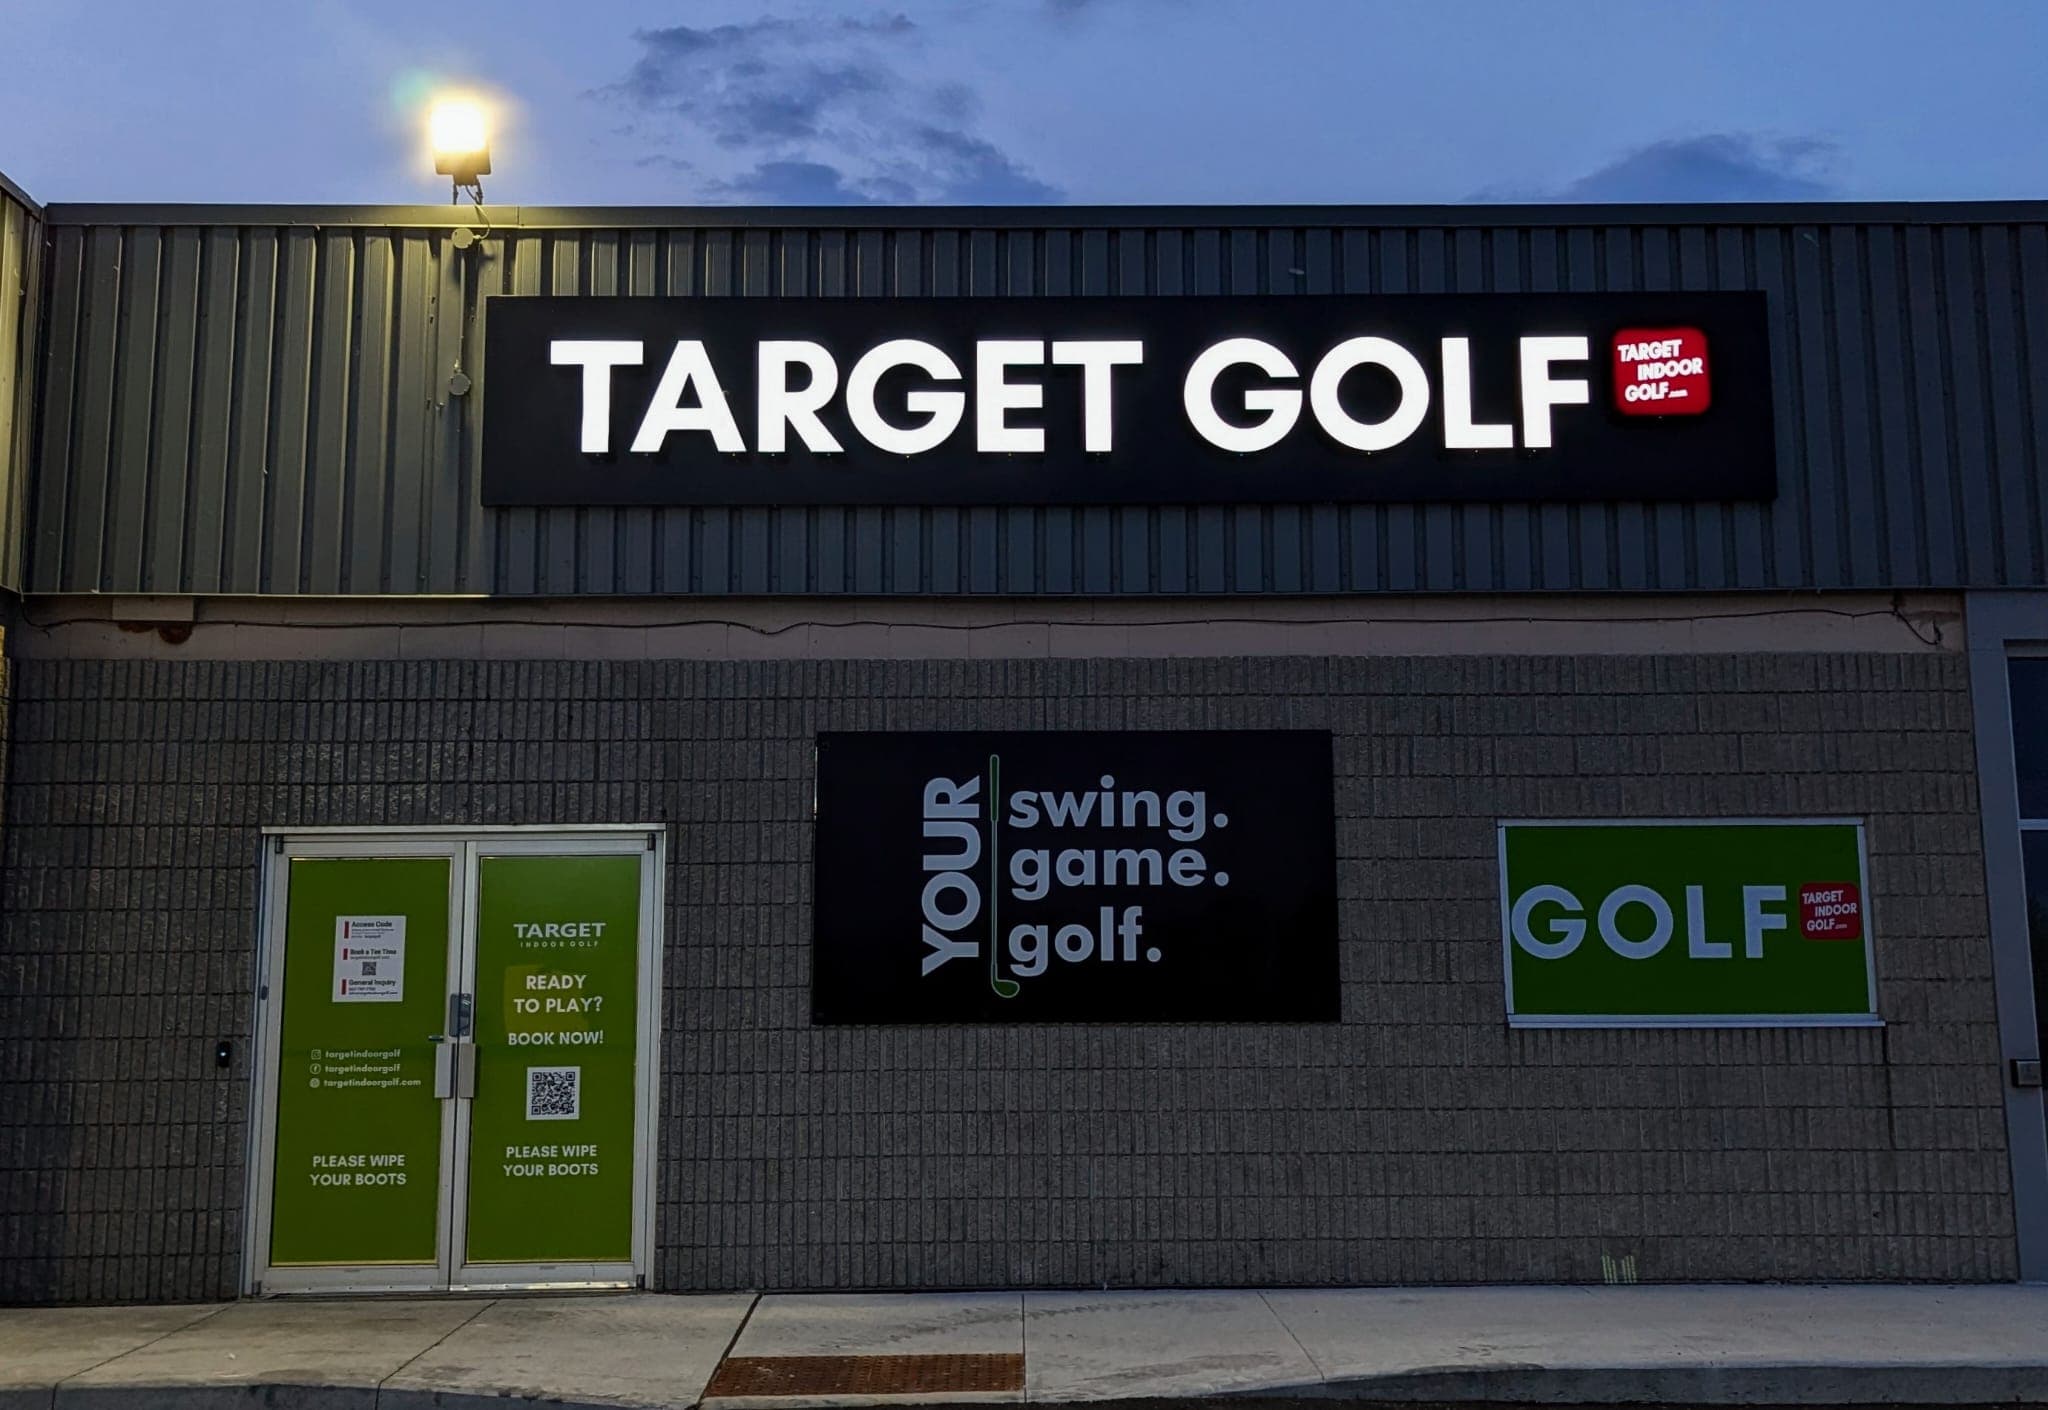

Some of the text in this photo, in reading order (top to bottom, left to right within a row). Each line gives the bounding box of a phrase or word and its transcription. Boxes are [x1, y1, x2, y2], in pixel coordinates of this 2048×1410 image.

[1617, 339, 1682, 362] TARGET
[1637, 357, 1704, 381] INDOOR
[550, 336, 1590, 454] TARGET GOLF
[1008, 774, 1229, 842] swing.
[921, 775, 981, 976] YOUR
[1008, 848, 1230, 900] game.
[1802, 890, 1844, 904] TARGET
[1815, 903, 1857, 917] INDOOR
[1511, 884, 1787, 959] GOLF
[513, 922, 606, 938] TARGET
[520, 941, 564, 949] INDOOR
[1008, 906, 1162, 977] golf.
[526, 974, 587, 990] READY
[513, 996, 603, 1013] TO PLAY?
[508, 1030, 604, 1046] BOOK NOW!
[325, 1049, 401, 1060] targetindoorgolf
[325, 1063, 401, 1075] targetindoorgolf
[323, 1078, 421, 1089] targetindoorgolf.com
[506, 1144, 597, 1158] PLEASE WIPE
[312, 1154, 405, 1168] PLEASE WIPE
[503, 1163, 599, 1177] YOUR BOOTS
[309, 1172, 407, 1186] YOUR BOOTS
